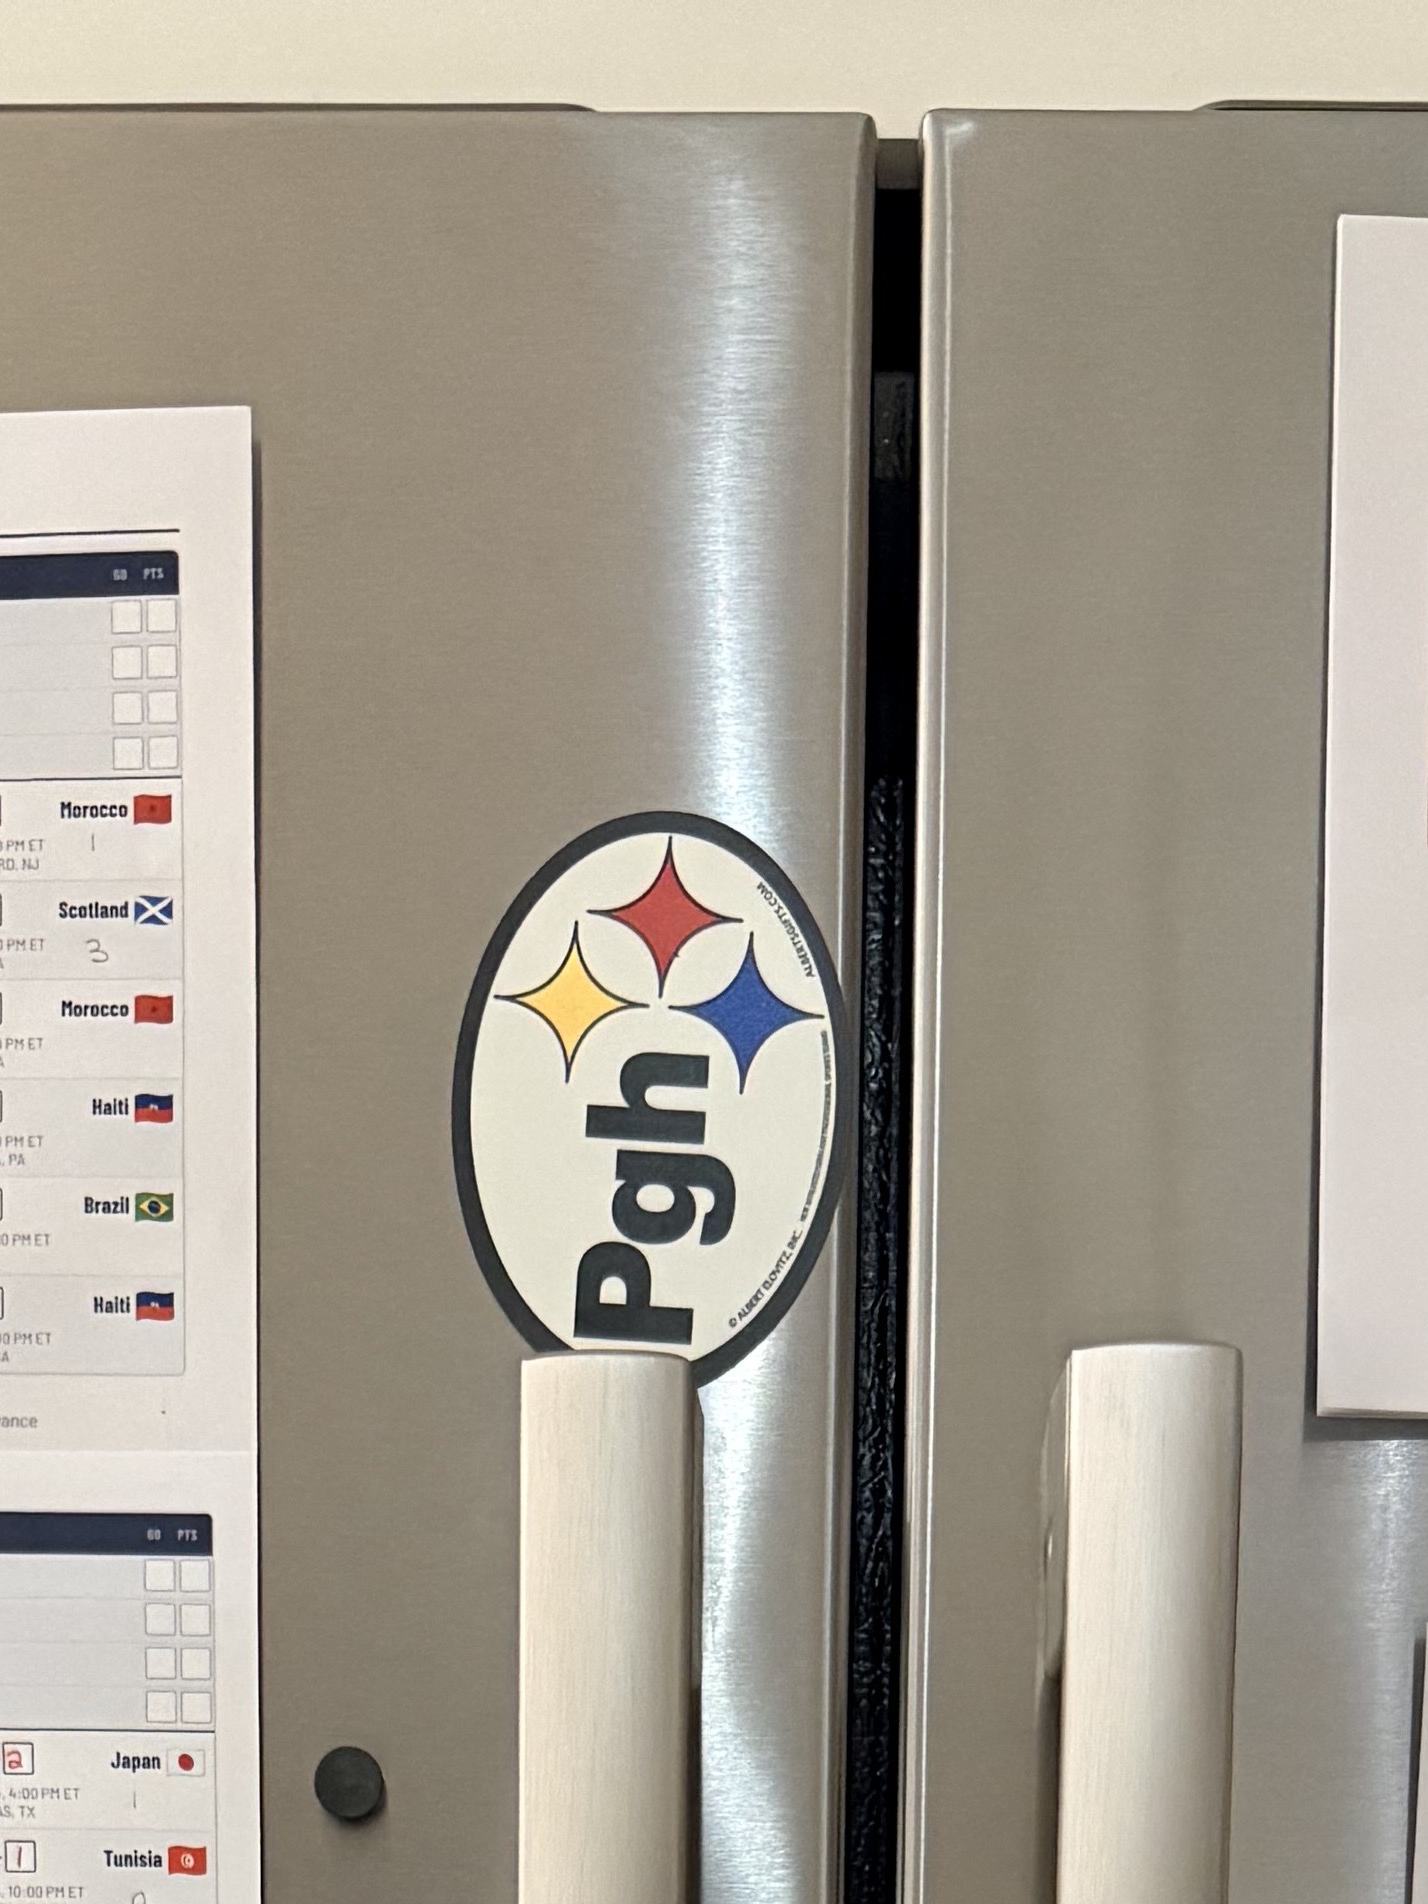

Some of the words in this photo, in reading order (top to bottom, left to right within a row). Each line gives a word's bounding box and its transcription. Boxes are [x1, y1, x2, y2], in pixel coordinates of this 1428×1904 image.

[61, 802, 128, 818] Morocco
[21, 858, 40, 871] NJ
[757, 882, 815, 978] ALBERTSGIFTS.COM
[86, 938, 110, 963] 3
[574, 1052, 736, 1345] Pgh
[111, 1752, 160, 1773] Japan
